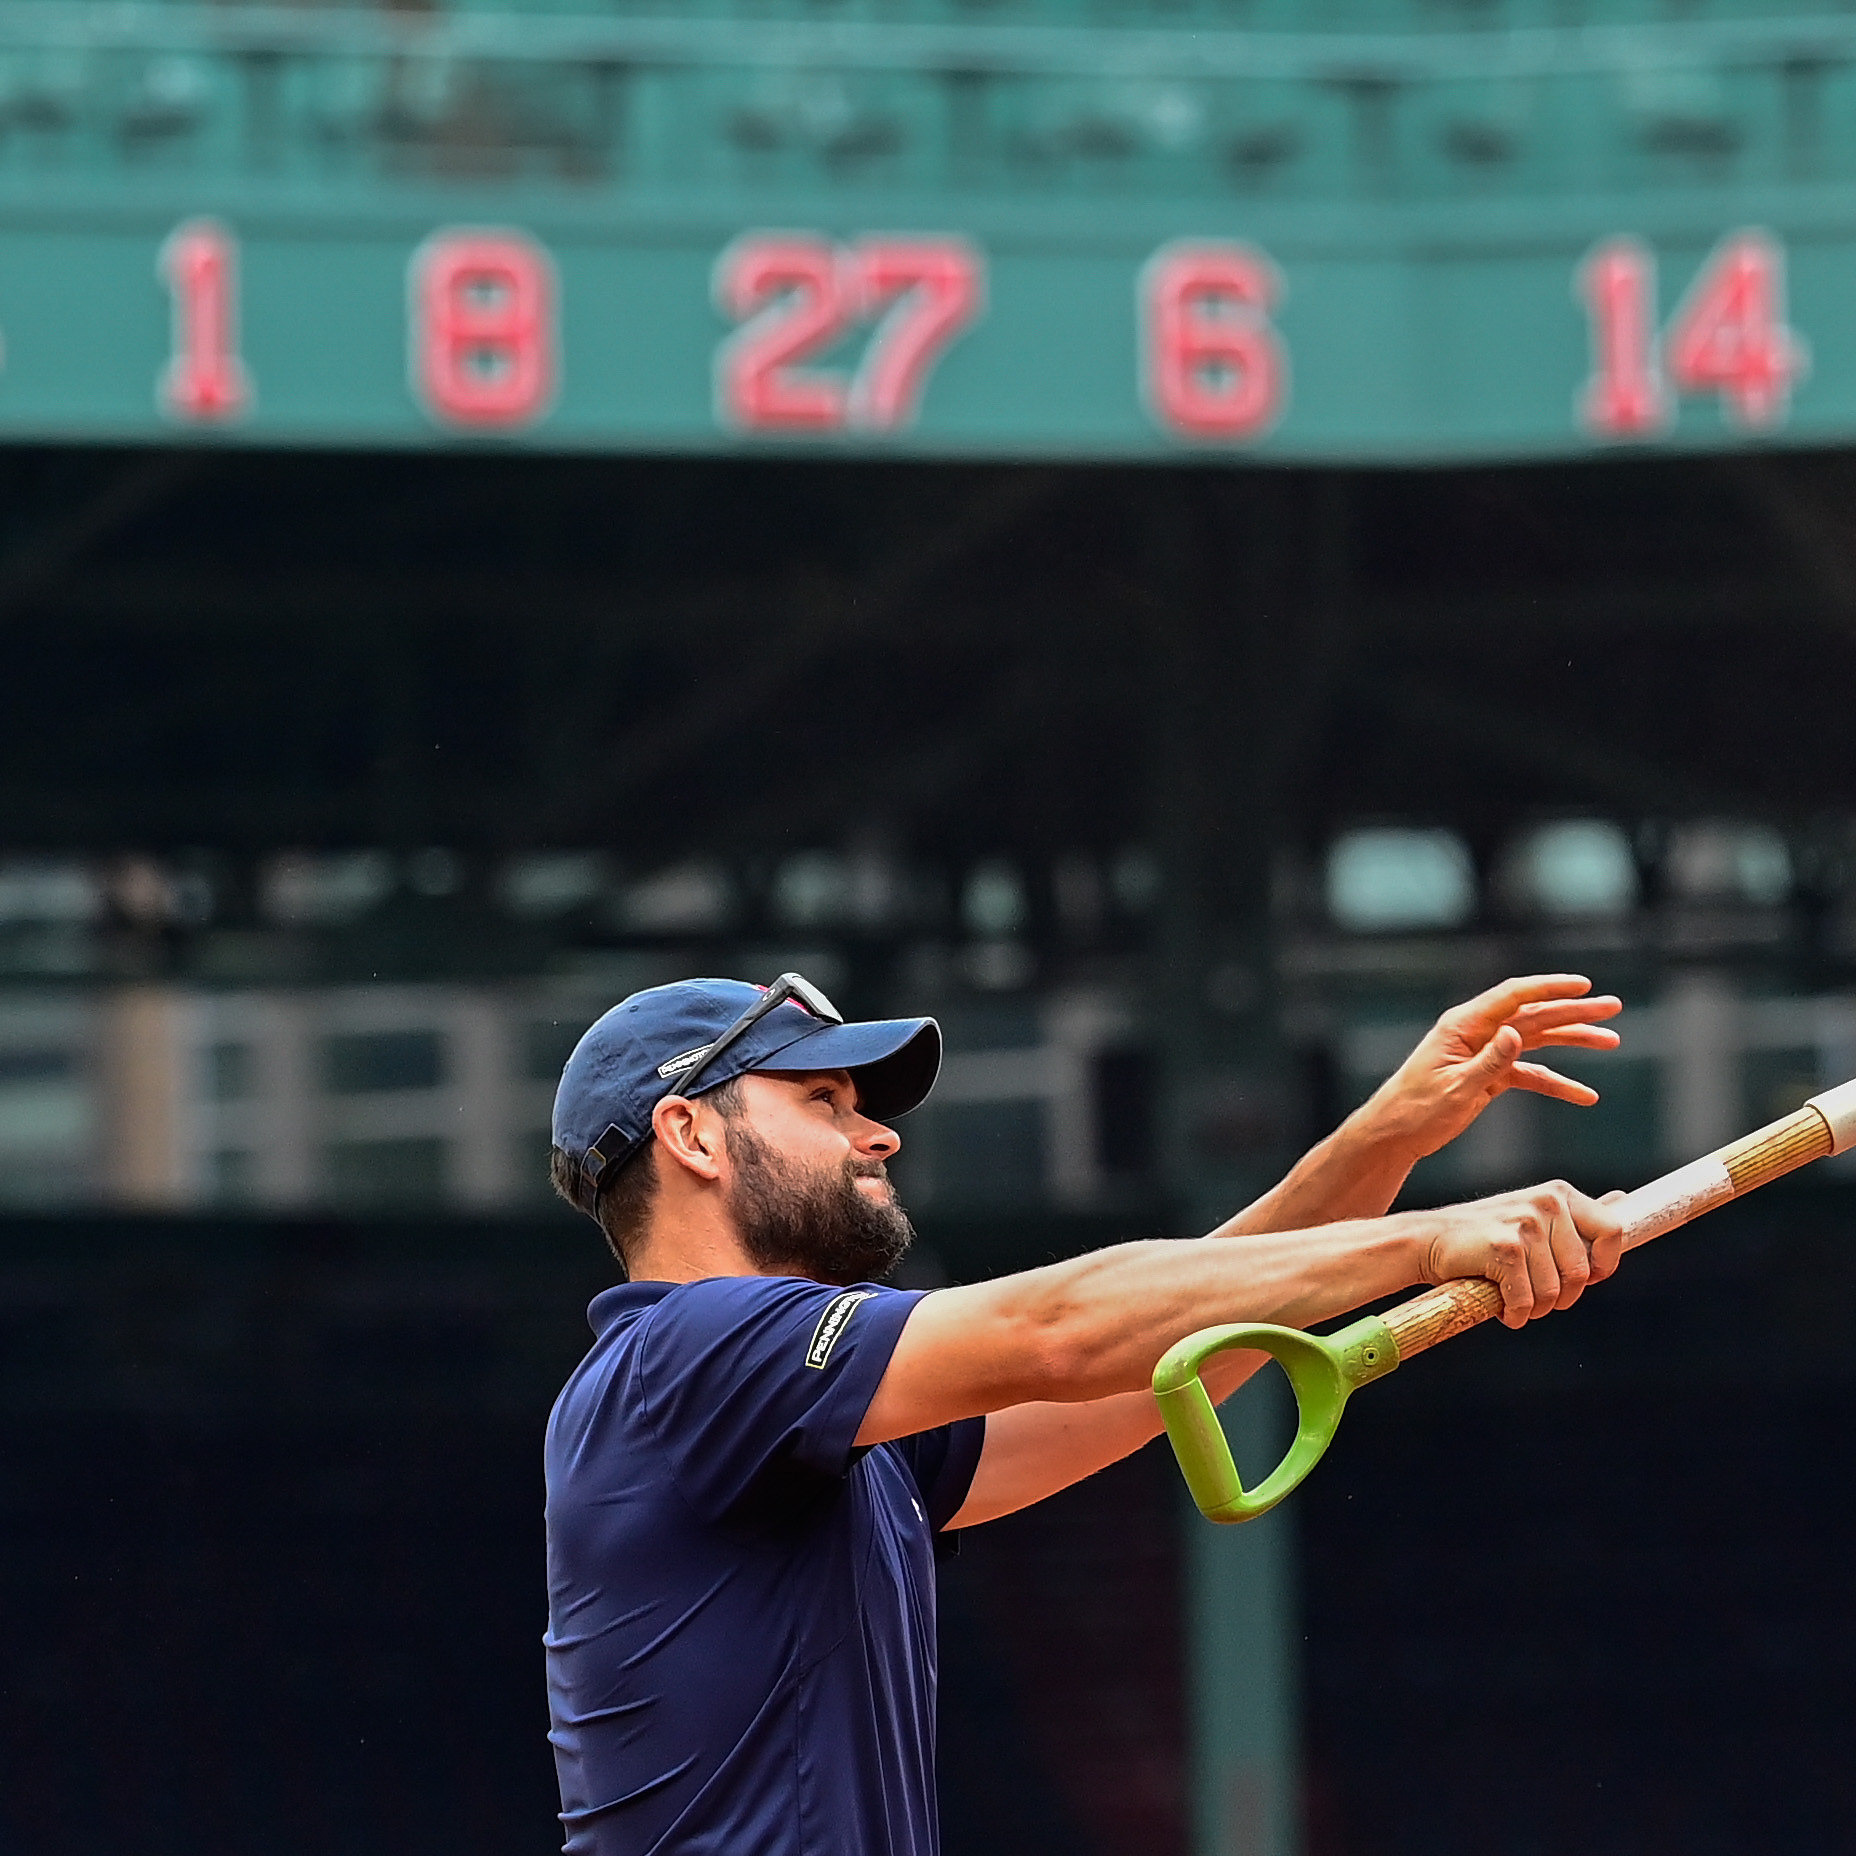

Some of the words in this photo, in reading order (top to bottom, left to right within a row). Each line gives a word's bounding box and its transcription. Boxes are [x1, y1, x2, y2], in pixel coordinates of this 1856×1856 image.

[156, 218, 254, 422] 1
[410, 225, 559, 428] 8
[714, 232, 984, 438] 27
[1140, 239, 1287, 445] 6
[1577, 226, 1808, 446] 14
[811, 1292, 868, 1363] PENNING
